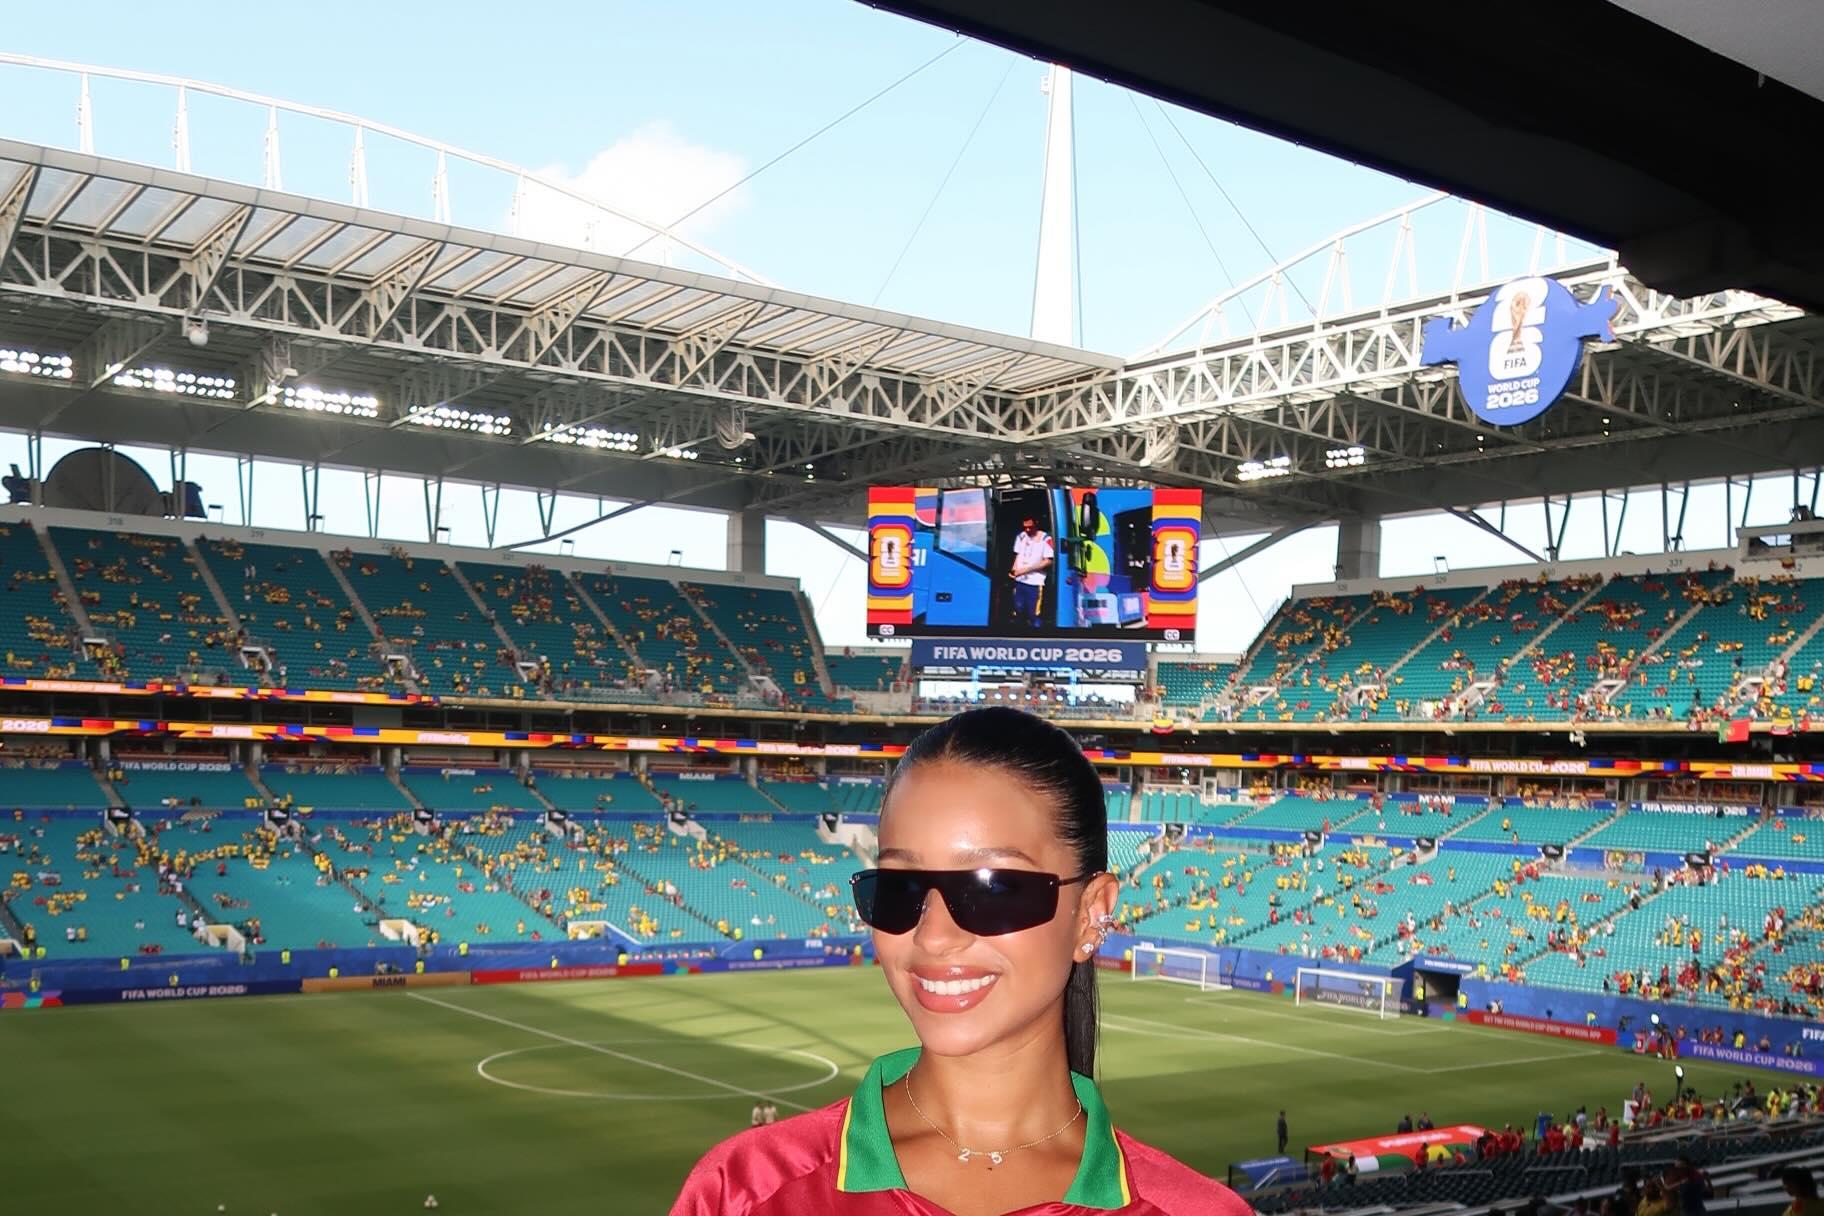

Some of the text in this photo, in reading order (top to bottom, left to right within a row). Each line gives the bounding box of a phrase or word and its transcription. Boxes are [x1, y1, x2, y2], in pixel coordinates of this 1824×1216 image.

[1504, 357, 1527, 370] FIFA
[1487, 377, 1540, 394] WORLD CUP
[1486, 388, 1539, 409] 2026
[934, 646, 1122, 663] FIFA WORLD CUP 2026
[2, 719, 49, 732] 2026
[120, 761, 231, 772] FIFA WORLD CUP 2026
[1470, 760, 1491, 773] FIFA
[1492, 761, 1529, 773] WORLD
[679, 772, 716, 781] MIAMI
[1641, 803, 1660, 814] FIFA
[1661, 804, 1694, 815] WORLD
[1695, 805, 1714, 815] CUP
[373, 976, 406, 988] MIAMI
[121, 984, 245, 1000] FIFA WORLD CUP 2026
[1693, 1044, 1814, 1072] FIFA WORLD CUP 2026
